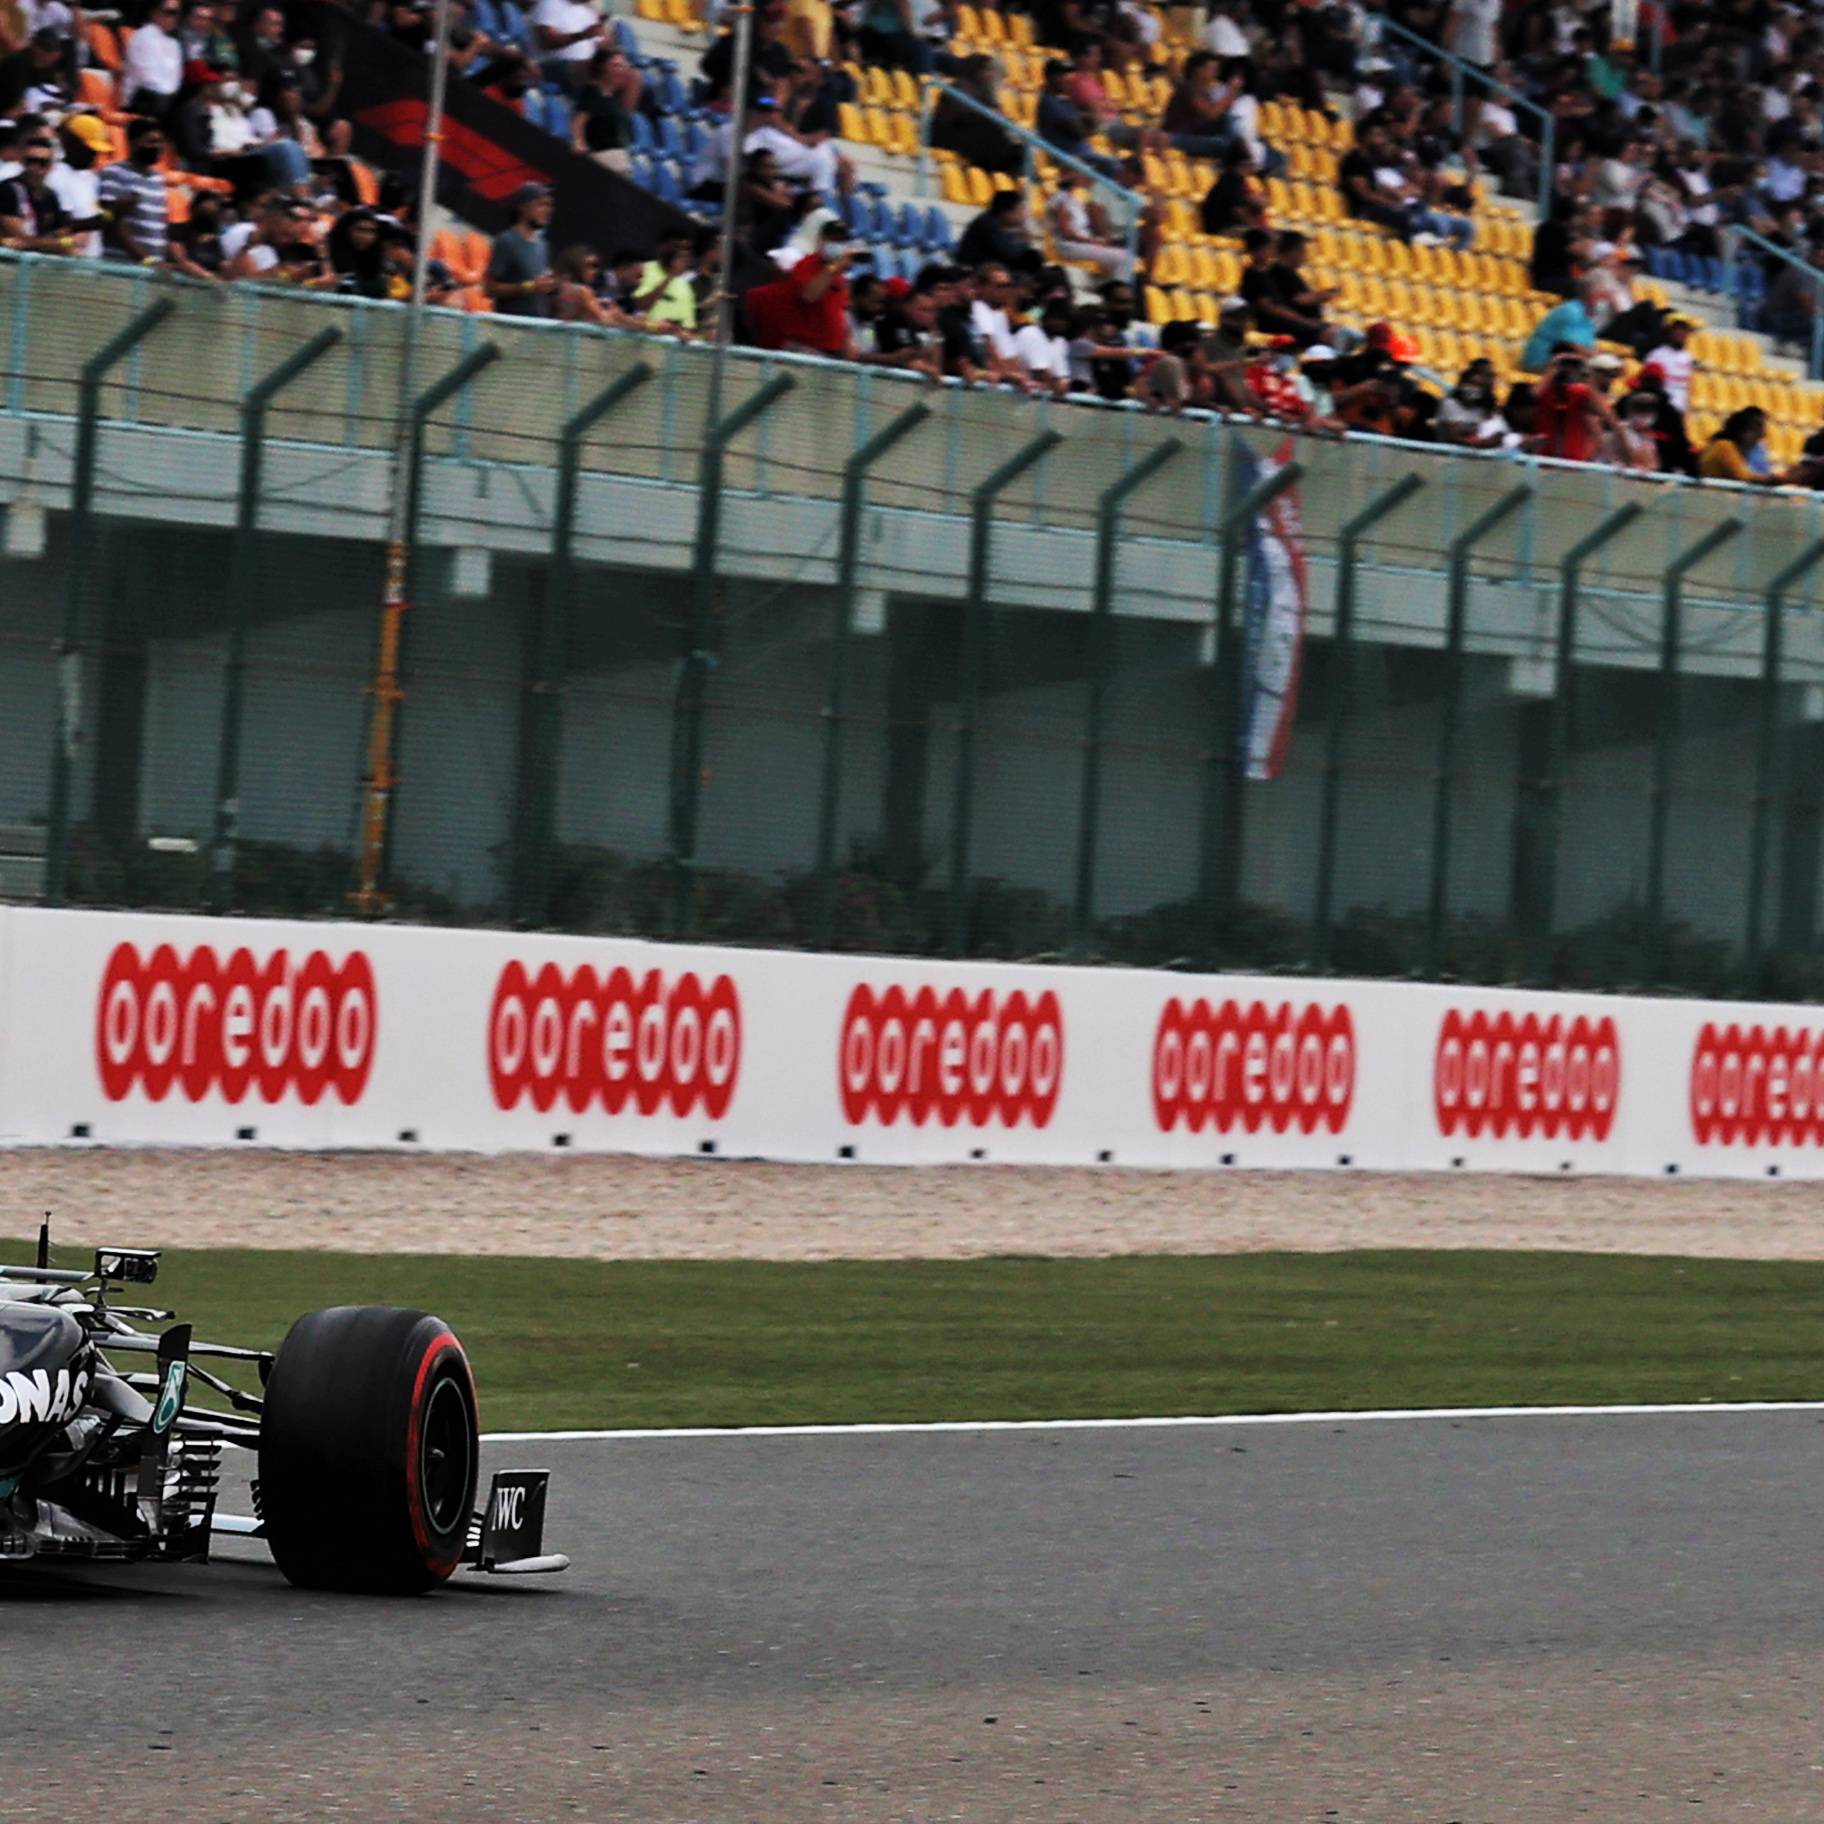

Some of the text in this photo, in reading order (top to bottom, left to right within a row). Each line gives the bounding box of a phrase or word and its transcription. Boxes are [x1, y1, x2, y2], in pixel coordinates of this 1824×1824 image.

[105, 947, 368, 1073] ooredoo
[496, 965, 734, 1088] ooredoo
[846, 987, 1056, 1100] ooredoo
[1159, 1001, 1349, 1107] ooredoo
[1441, 1013, 1614, 1115] ooredoo
